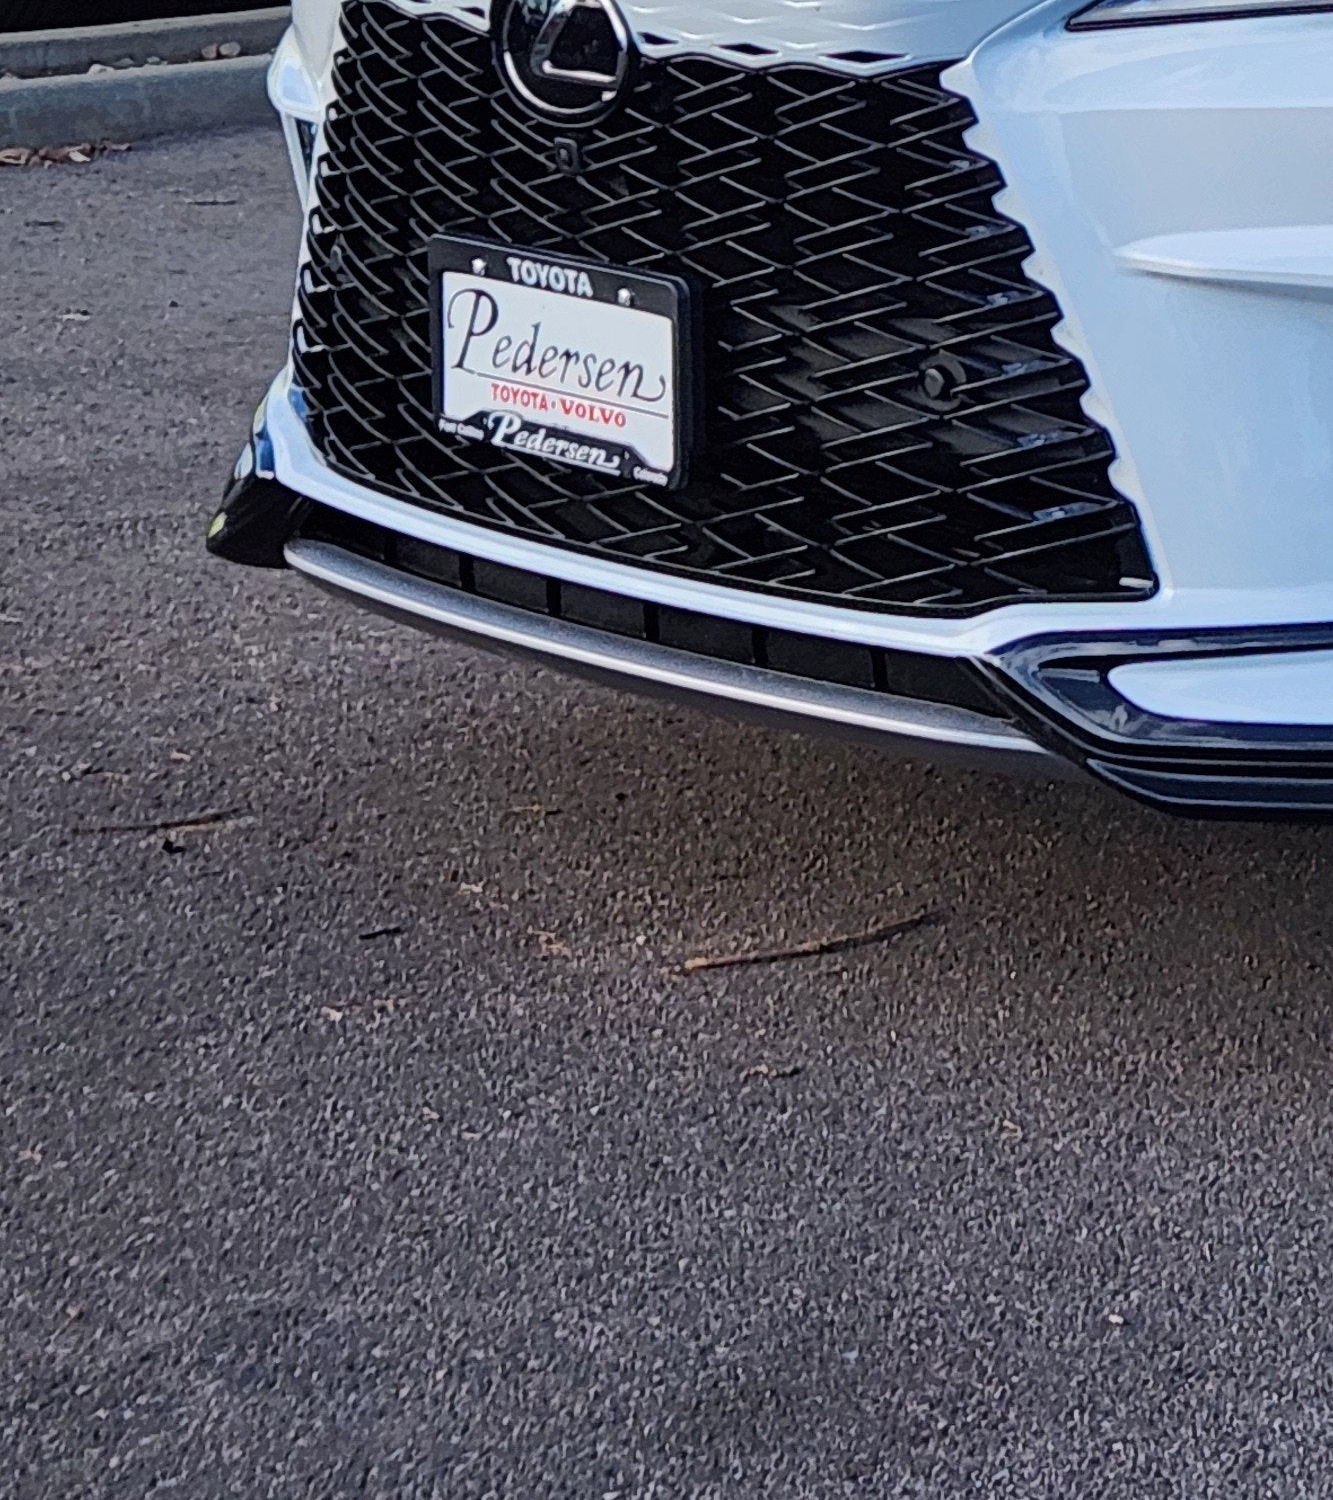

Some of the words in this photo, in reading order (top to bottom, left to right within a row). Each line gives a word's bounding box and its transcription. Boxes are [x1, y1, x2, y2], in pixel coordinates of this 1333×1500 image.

[506, 256, 594, 298] TOYOTA
[447, 288, 666, 402] Pedersen
[487, 410, 621, 468] Pedersen
